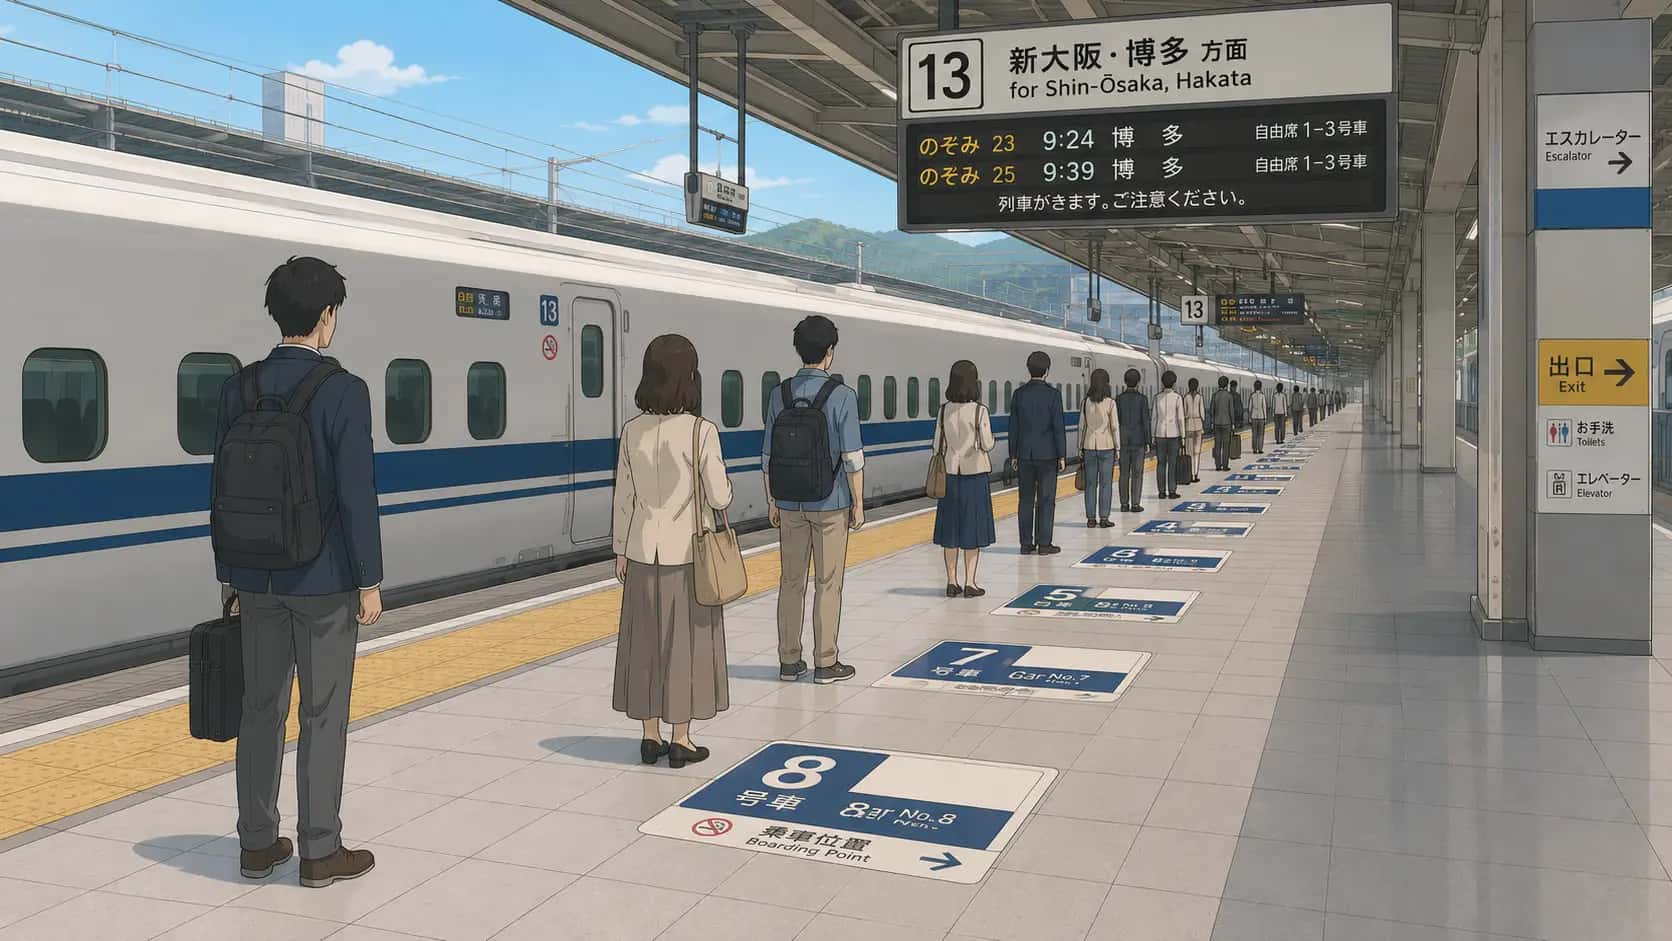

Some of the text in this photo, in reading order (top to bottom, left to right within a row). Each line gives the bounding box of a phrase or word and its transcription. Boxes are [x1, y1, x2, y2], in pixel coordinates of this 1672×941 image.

[1201, 38, 1248, 62] 方面
[918, 51, 971, 100] 13
[1009, 70, 1252, 99] for Shin-Ōsaka, Hakata
[919, 135, 980, 156] のぞみ
[992, 134, 1015, 153] 23
[1043, 129, 1095, 151] 9:24
[1545, 129, 1641, 146] エスカレーター
[1545, 151, 1592, 162] Escalator
[919, 166, 980, 186] のぞみ
[992, 165, 1015, 183] 25
[1043, 161, 1095, 182] 9:39
[541, 299, 557, 322] 13
[1185, 300, 1204, 319] 13
[1549, 355, 1594, 377] 出口
[1559, 380, 1586, 393] Exit
[1577, 421, 1614, 435] お手洗
[1577, 473, 1641, 486] エレベーター
[1577, 488, 1612, 498] Elevator
[1044, 588, 1083, 601] 5
[949, 647, 999, 666] 7
[761, 755, 837, 790] 8
[735, 789, 806, 812] 号車
[745, 837, 872, 864] Boarding Point
